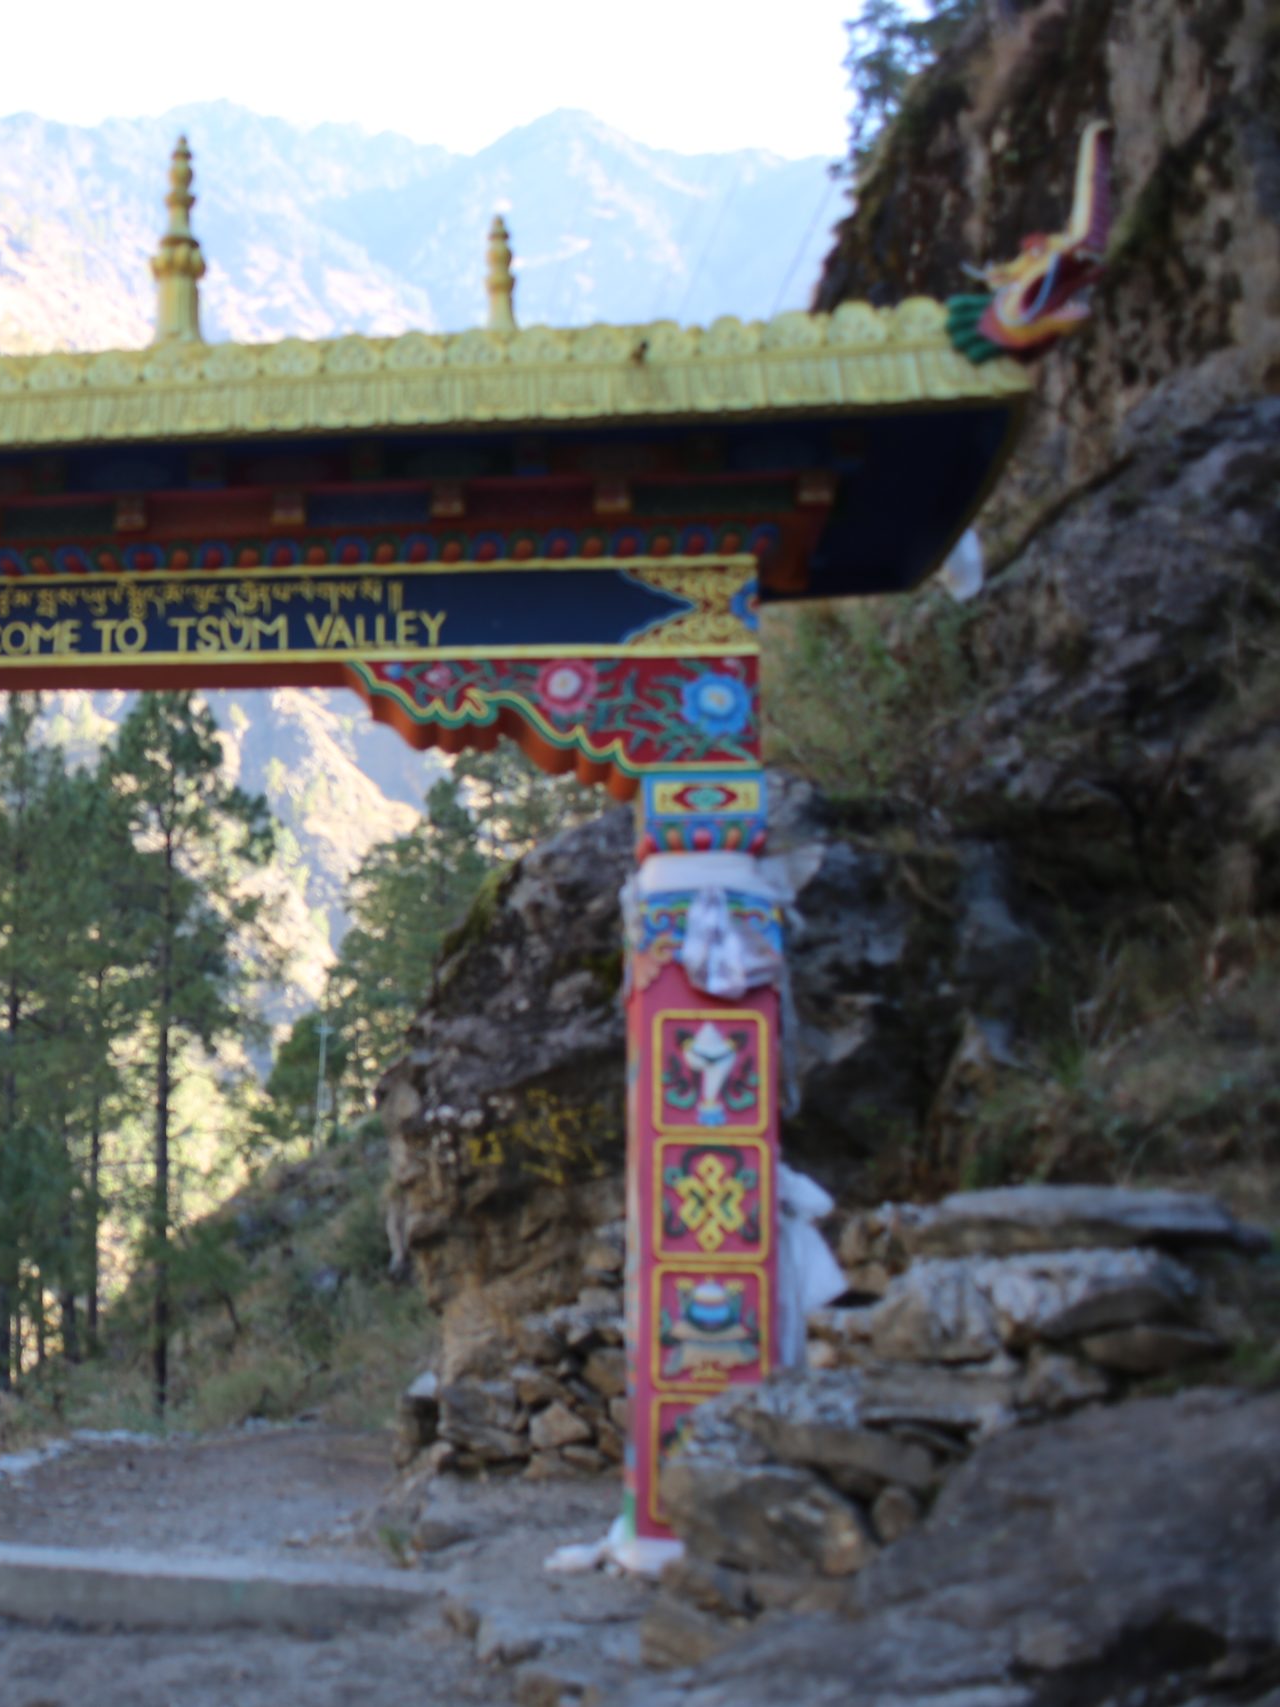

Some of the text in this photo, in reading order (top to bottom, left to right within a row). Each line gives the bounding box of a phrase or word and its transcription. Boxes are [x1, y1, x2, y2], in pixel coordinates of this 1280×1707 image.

[92, 618, 147, 654] TO
[167, 613, 288, 653] TSUM
[305, 610, 446, 649] VALLEY
